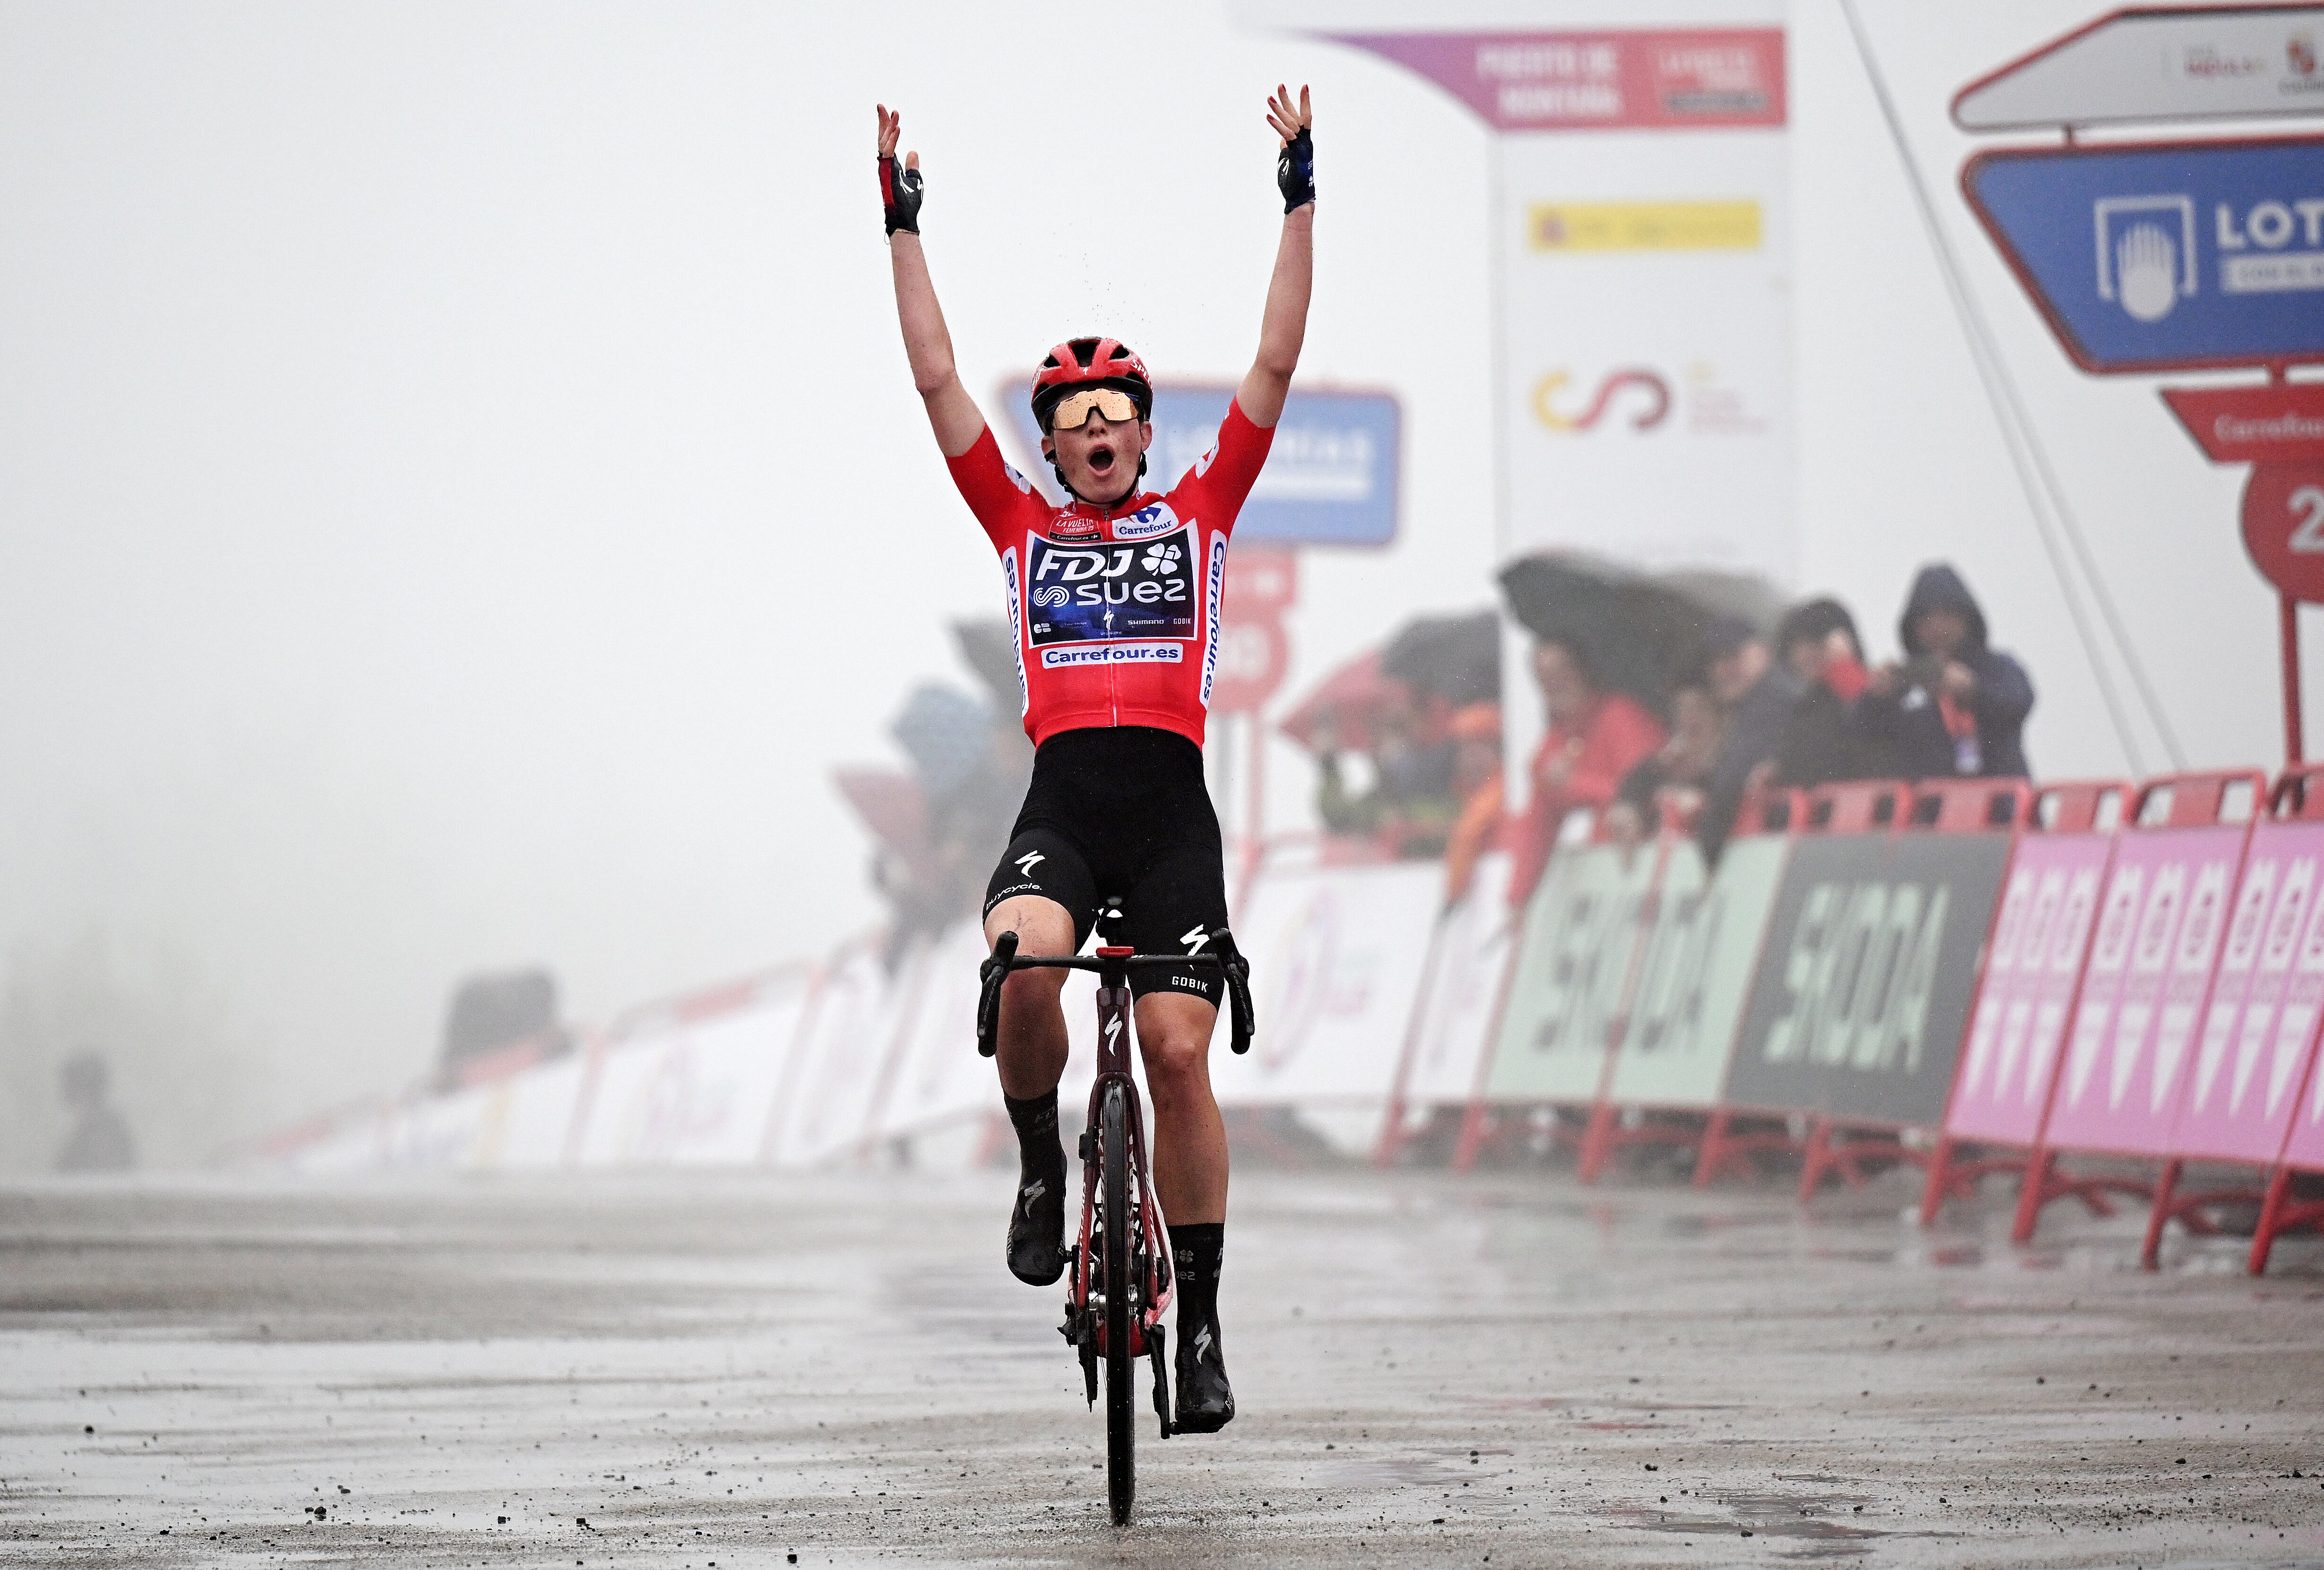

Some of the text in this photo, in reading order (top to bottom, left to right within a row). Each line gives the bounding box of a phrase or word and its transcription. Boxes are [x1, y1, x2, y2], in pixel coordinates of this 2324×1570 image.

[1119, 520, 1172, 535] Carrefour
[1036, 548, 1134, 581] FDJ
[1203, 541, 1224, 701] Carrefour.es
[1045, 647, 1179, 664] Carrefour.es
[1171, 976, 1208, 992] GOBIK
